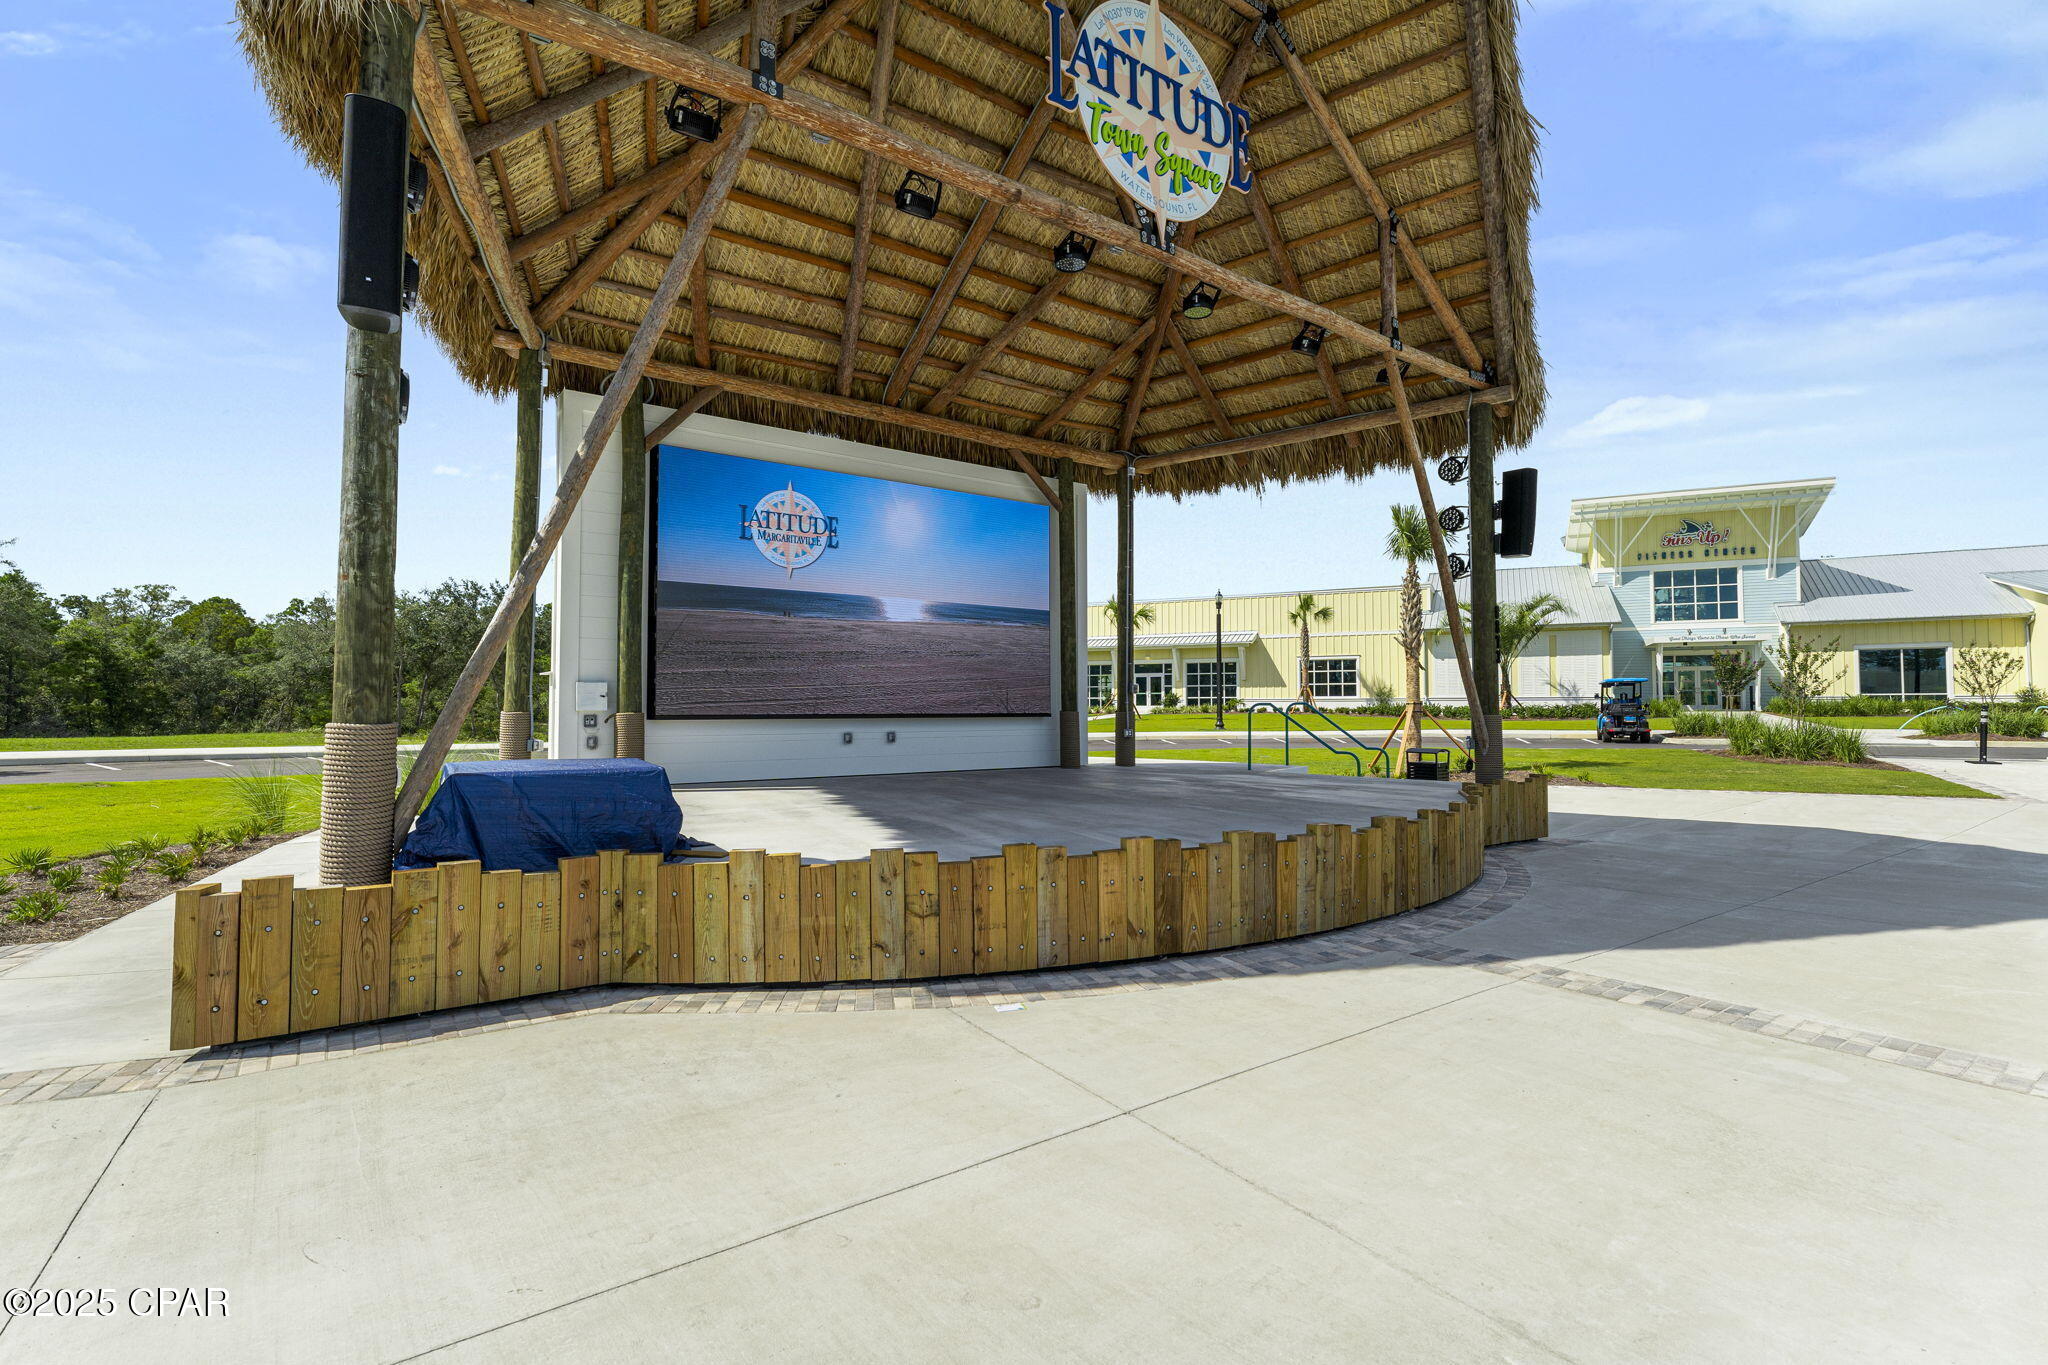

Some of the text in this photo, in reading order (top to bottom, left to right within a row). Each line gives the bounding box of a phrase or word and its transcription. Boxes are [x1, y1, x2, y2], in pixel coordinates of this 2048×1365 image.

[1045, 0, 1253, 193] LATITUDE
[1086, 100, 1223, 196] Town Square
[739, 504, 839, 549] LATITUDE
